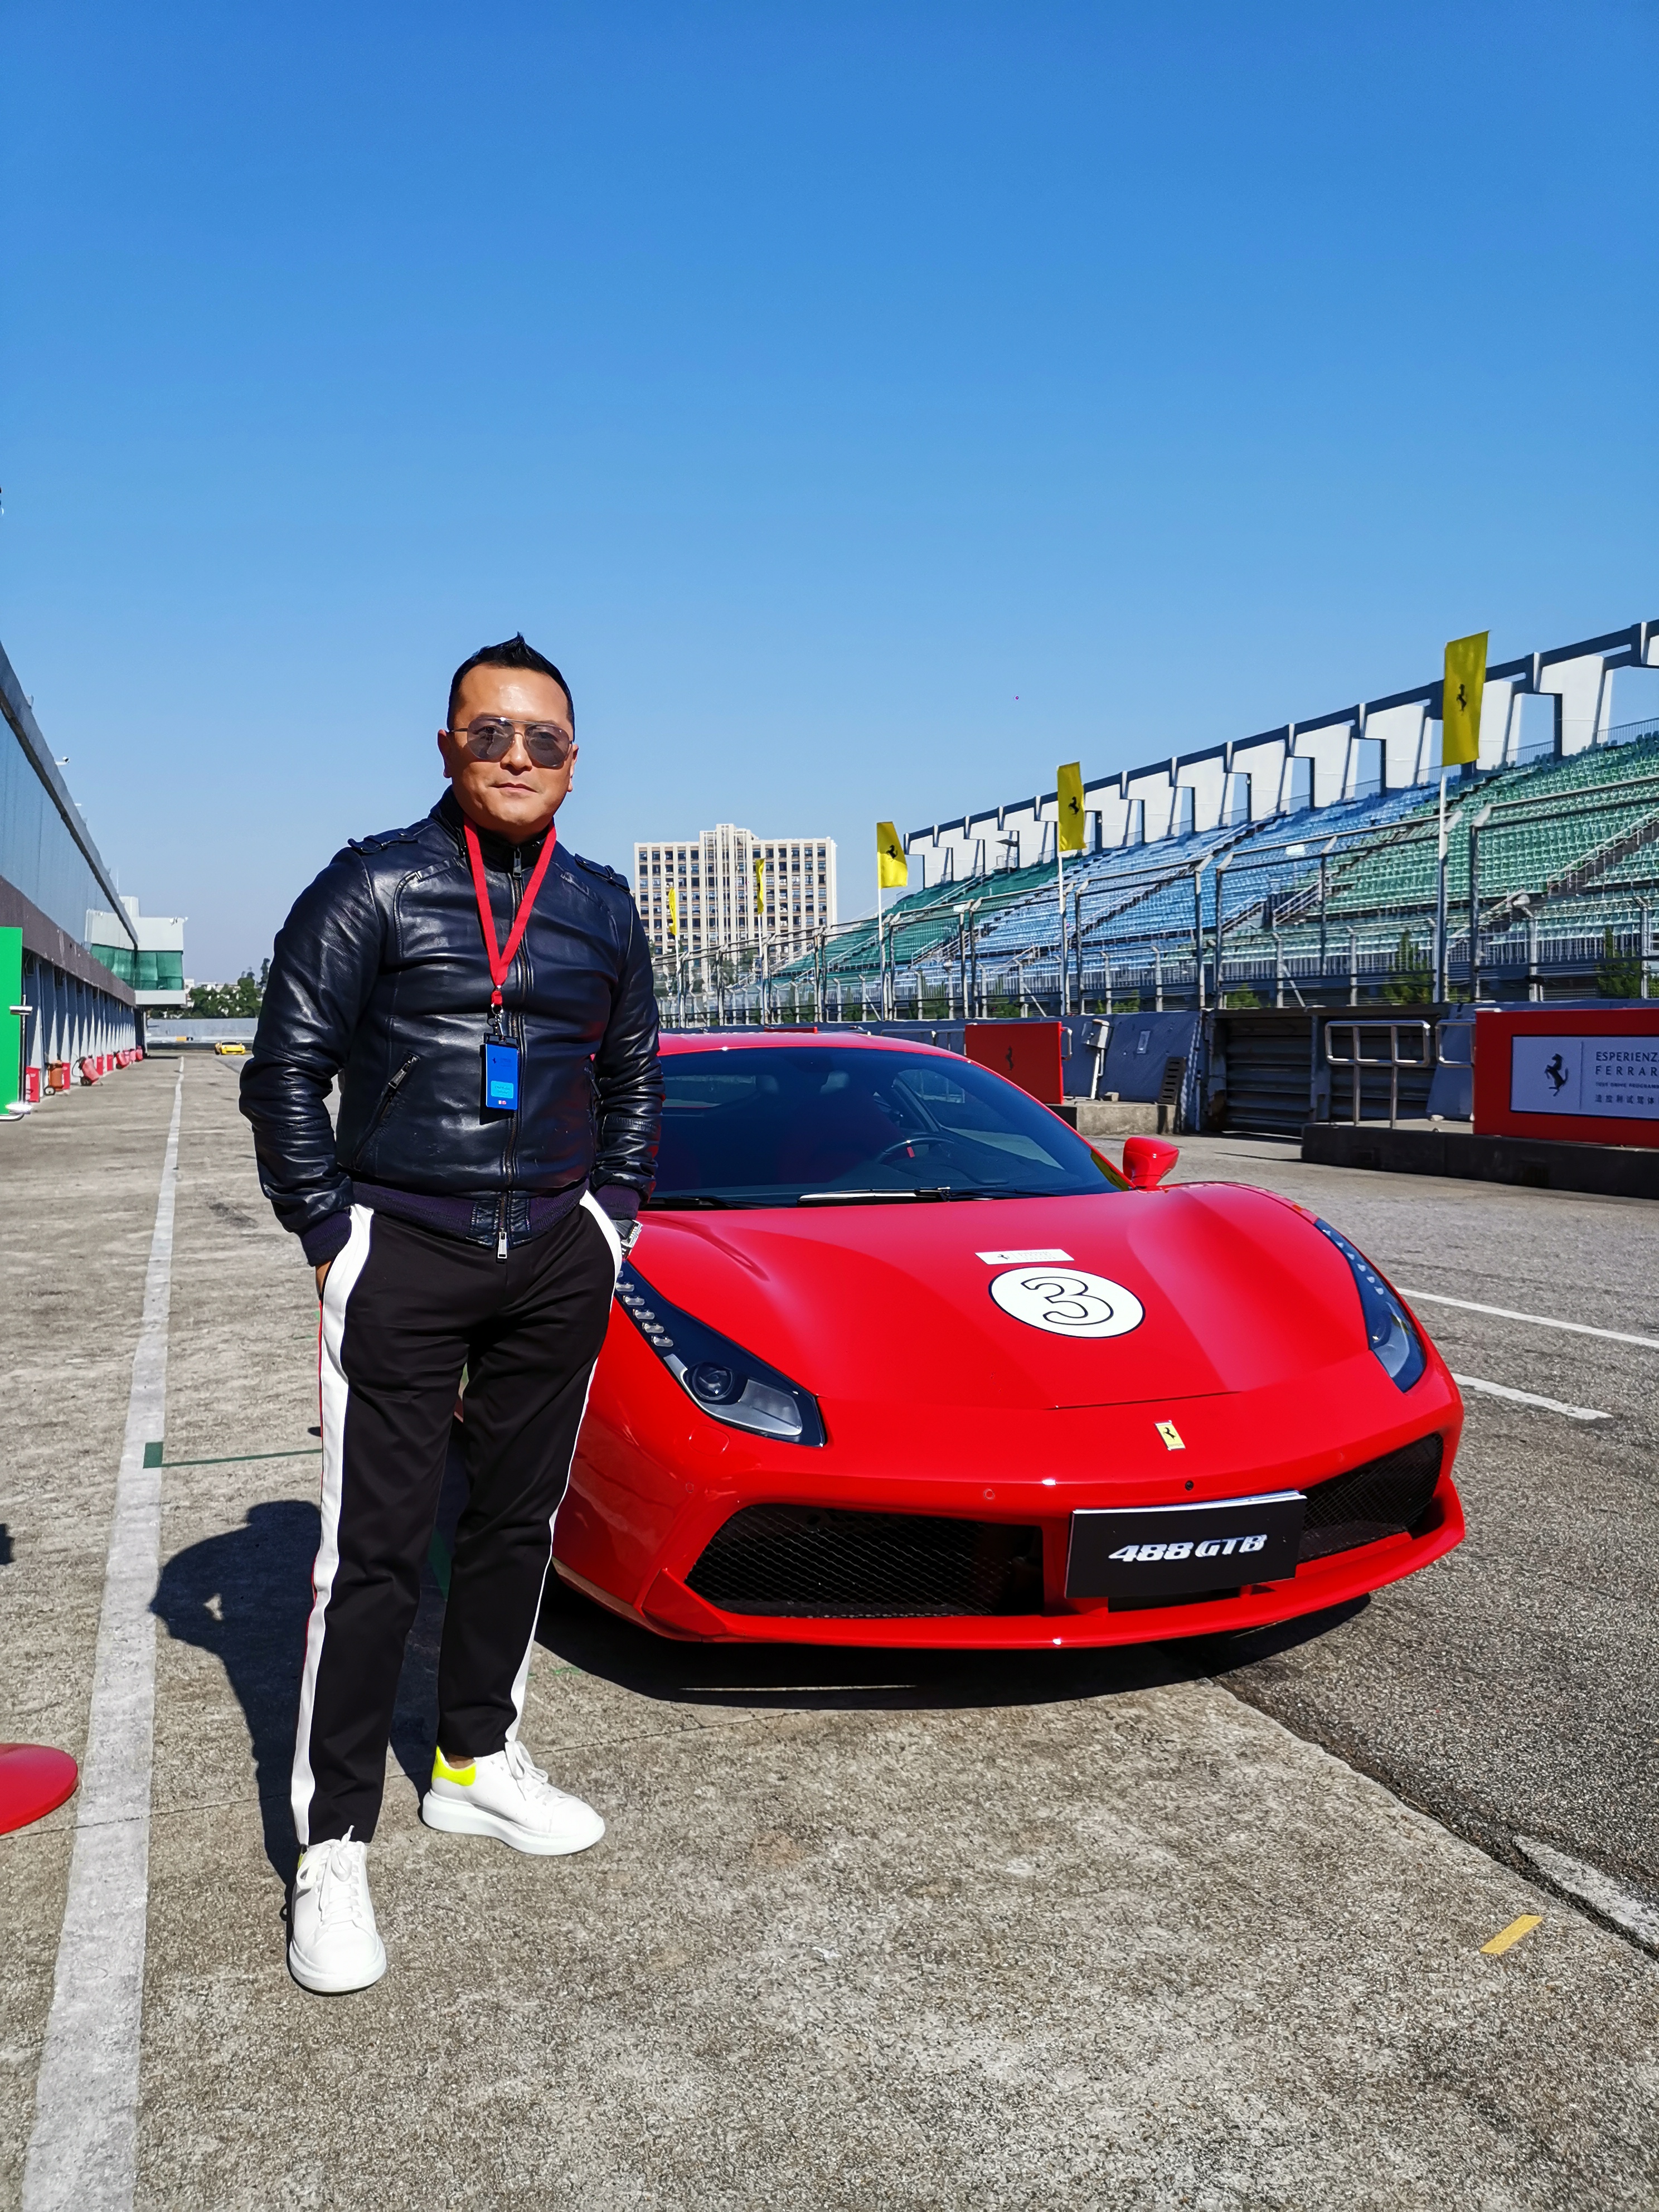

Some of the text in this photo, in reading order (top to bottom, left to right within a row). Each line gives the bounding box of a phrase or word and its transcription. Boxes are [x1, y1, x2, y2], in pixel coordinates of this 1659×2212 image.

[1595, 1051, 1659, 1063] ESPERIENZ
[1020, 1276, 1114, 1326] 3
[1108, 1534, 1268, 1562] 488 GTB
